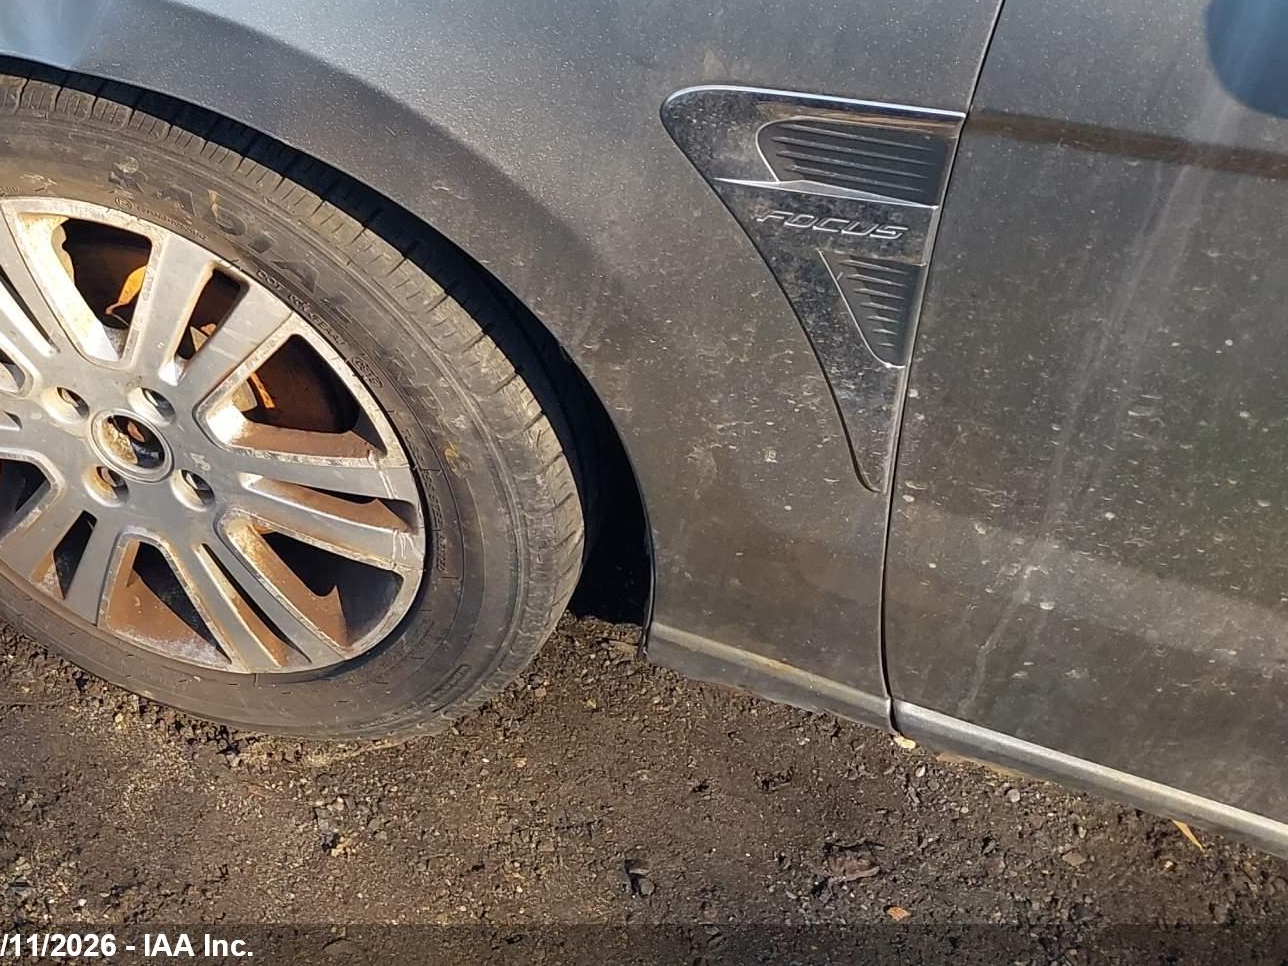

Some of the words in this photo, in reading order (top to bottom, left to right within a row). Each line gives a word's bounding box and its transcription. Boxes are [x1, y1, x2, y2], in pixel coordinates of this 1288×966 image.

[757, 211, 909, 240] FOCUS
[108, 156, 358, 326] RADIAL
[256, 267, 285, 292] DOT
